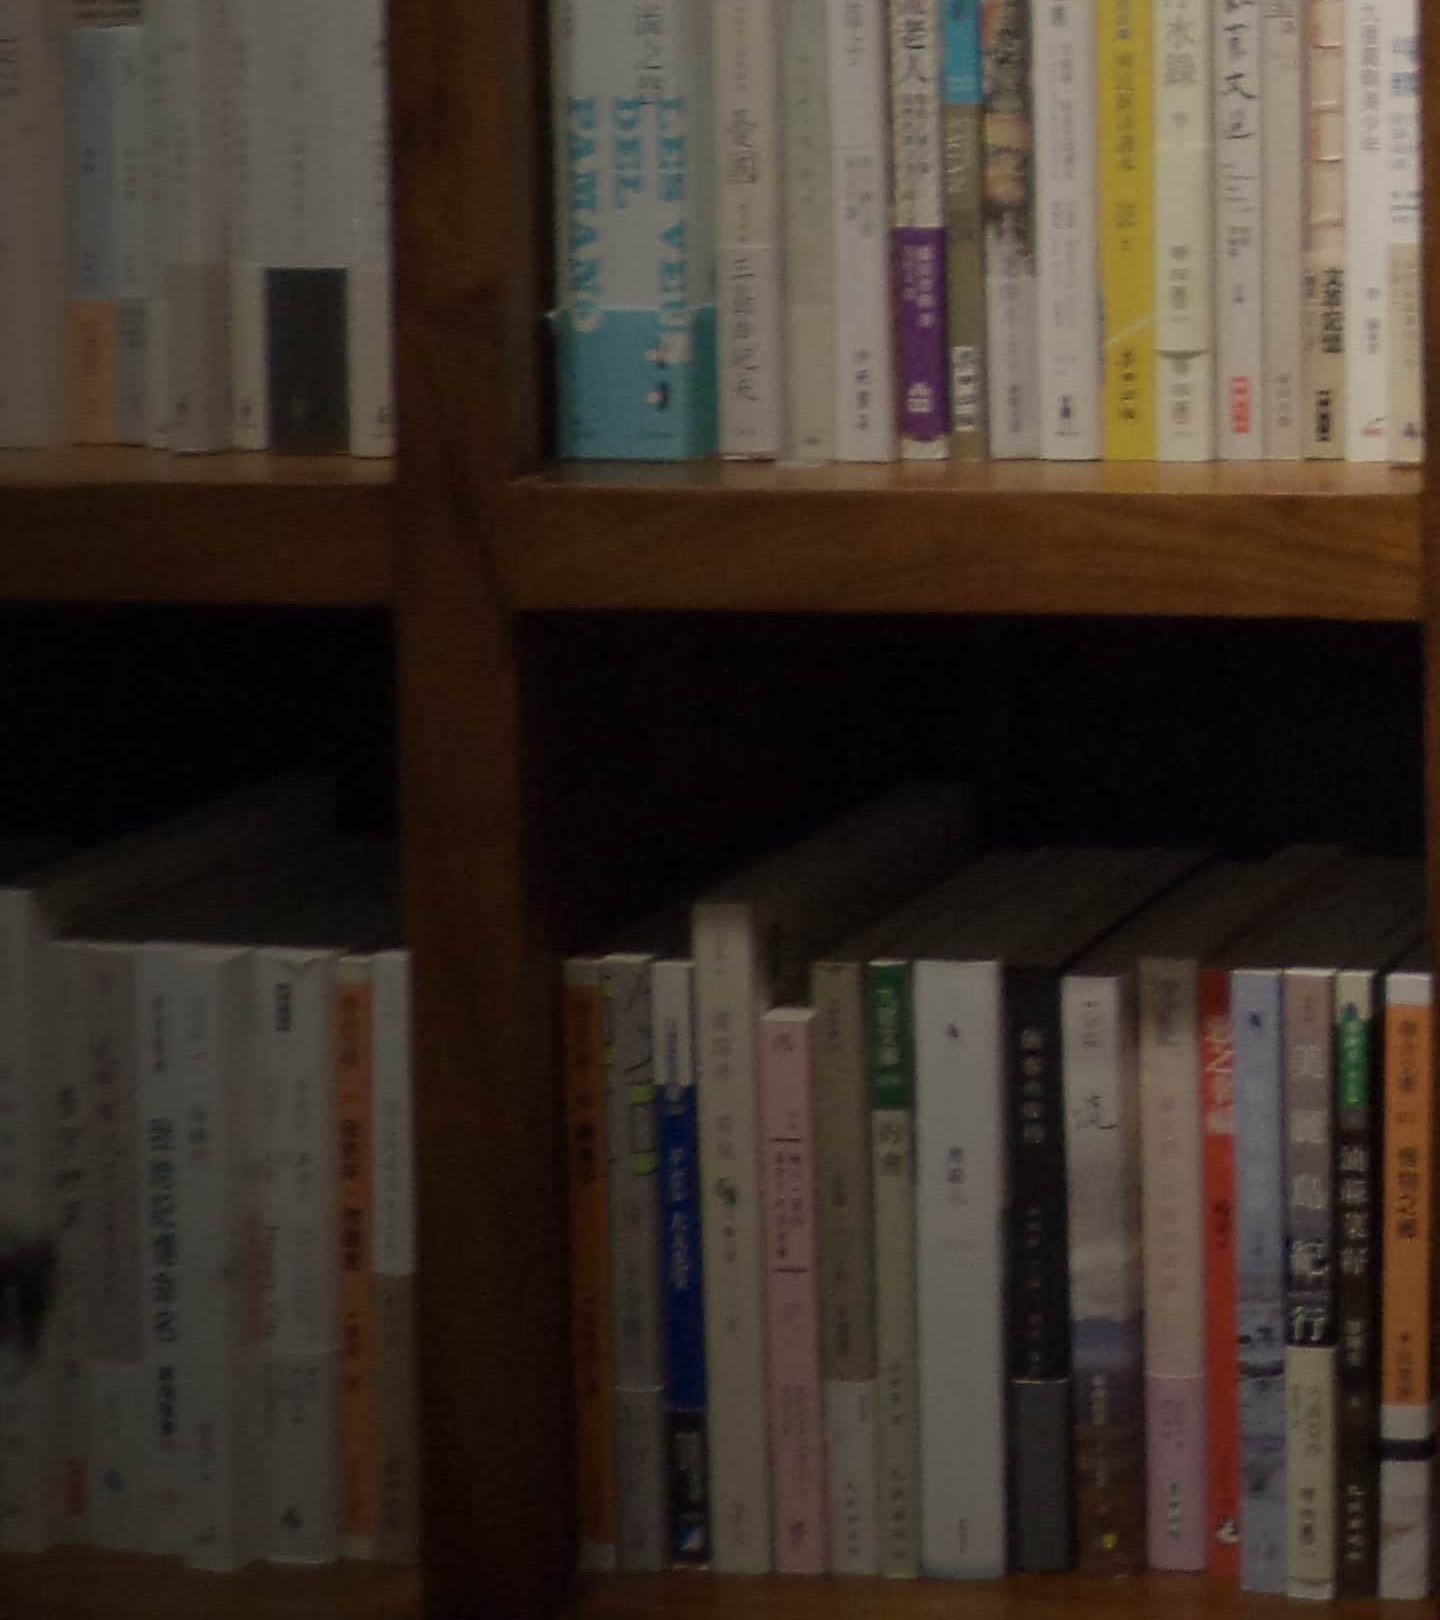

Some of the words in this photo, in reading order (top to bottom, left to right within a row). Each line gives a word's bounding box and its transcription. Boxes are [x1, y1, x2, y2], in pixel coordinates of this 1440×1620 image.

[612, 94, 645, 210] DEL
[656, 95, 688, 204] LES
[568, 94, 602, 335] PAMANO
